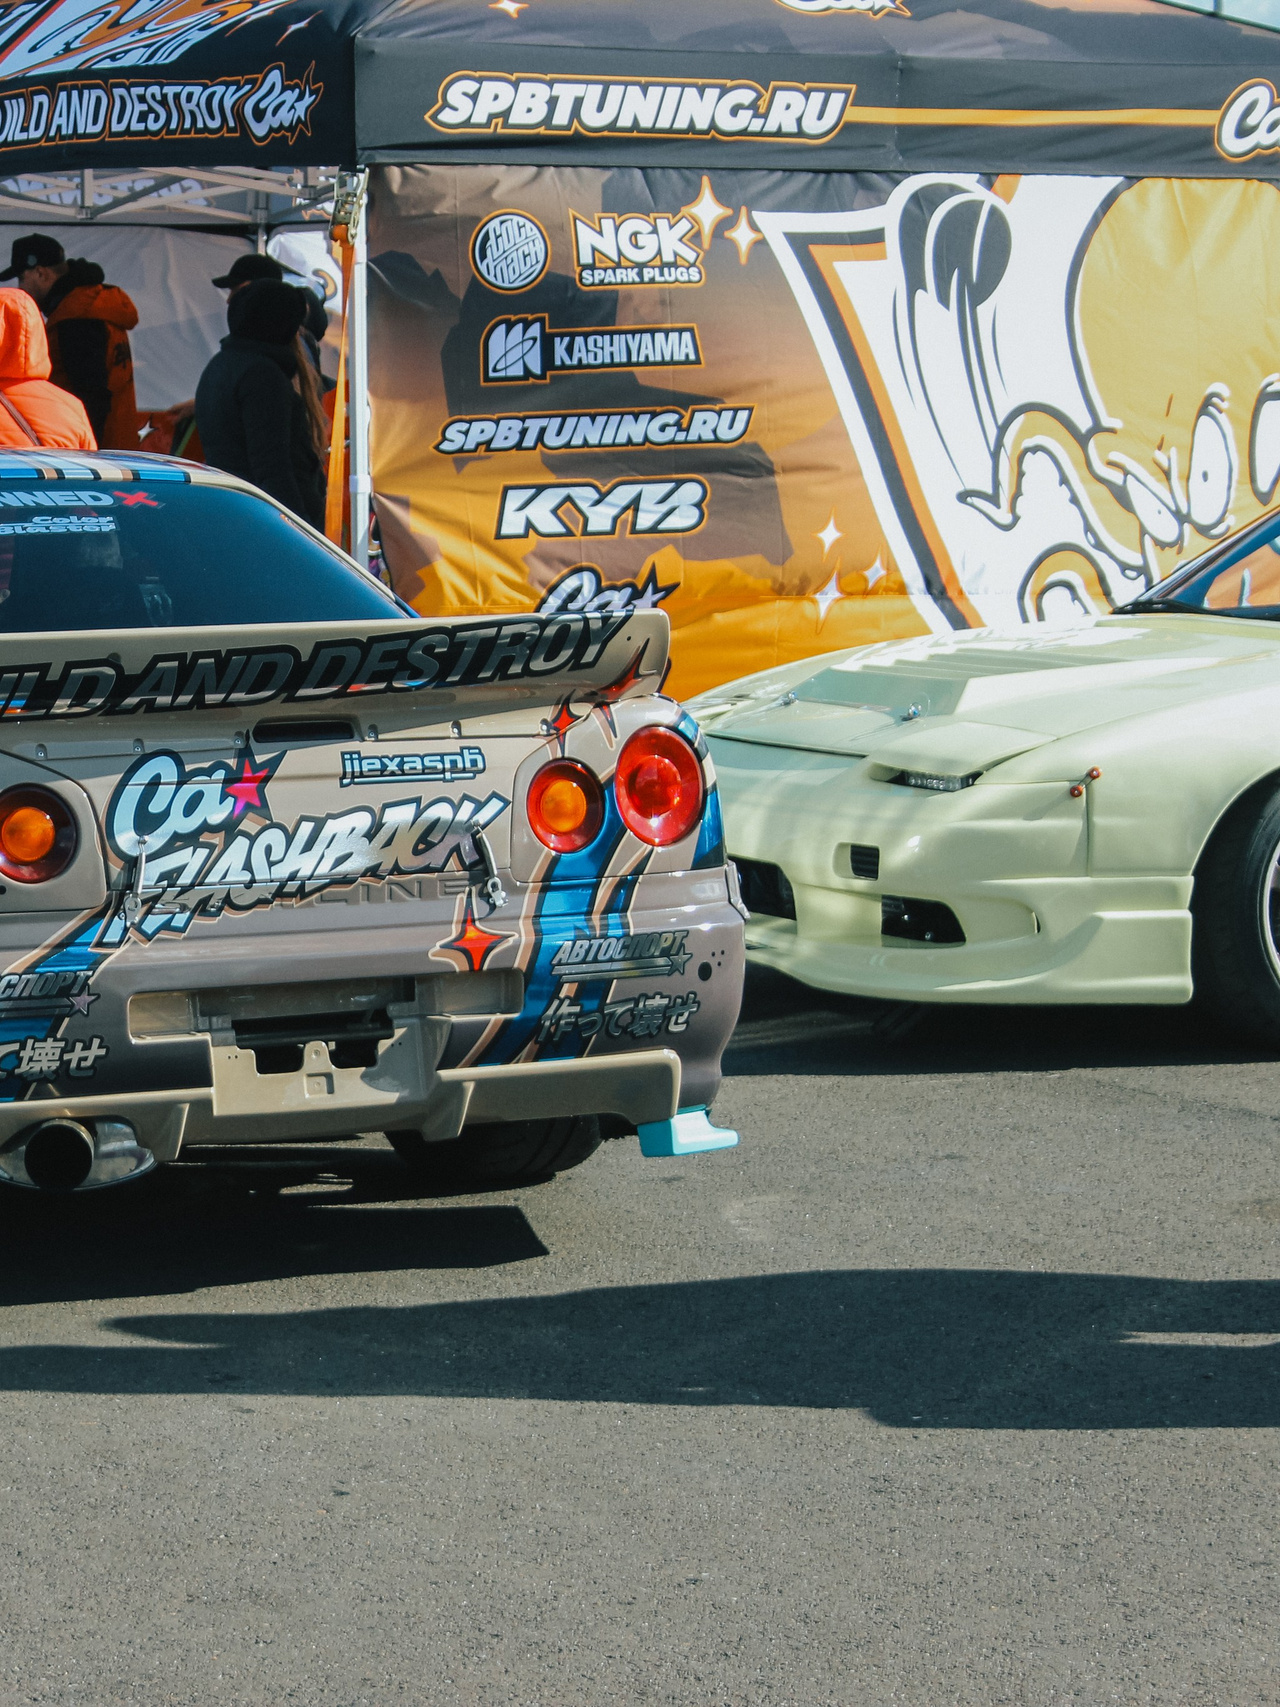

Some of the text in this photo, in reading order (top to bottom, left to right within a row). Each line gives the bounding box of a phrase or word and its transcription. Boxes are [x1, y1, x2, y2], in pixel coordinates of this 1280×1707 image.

[48, 88, 110, 138] AND
[109, 83, 252, 132] DESTROY
[437, 79, 846, 135] SPBTUNING.RU
[576, 217, 700, 266] NGK
[581, 267, 701, 285] SPARK PLUGS
[554, 331, 696, 366] KASHIYAMA
[438, 409, 750, 451] SPBTUNING.RU
[32, 516, 114, 525] Color
[500, 481, 704, 536] KYB
[118, 651, 295, 710] AND
[294, 610, 630, 698] DESTROY
[102, 792, 506, 944] FLASHBACK
[552, 930, 689, 965] АВТОСПОРТ
[538, 993, 699, 1042] 作って壊せ
